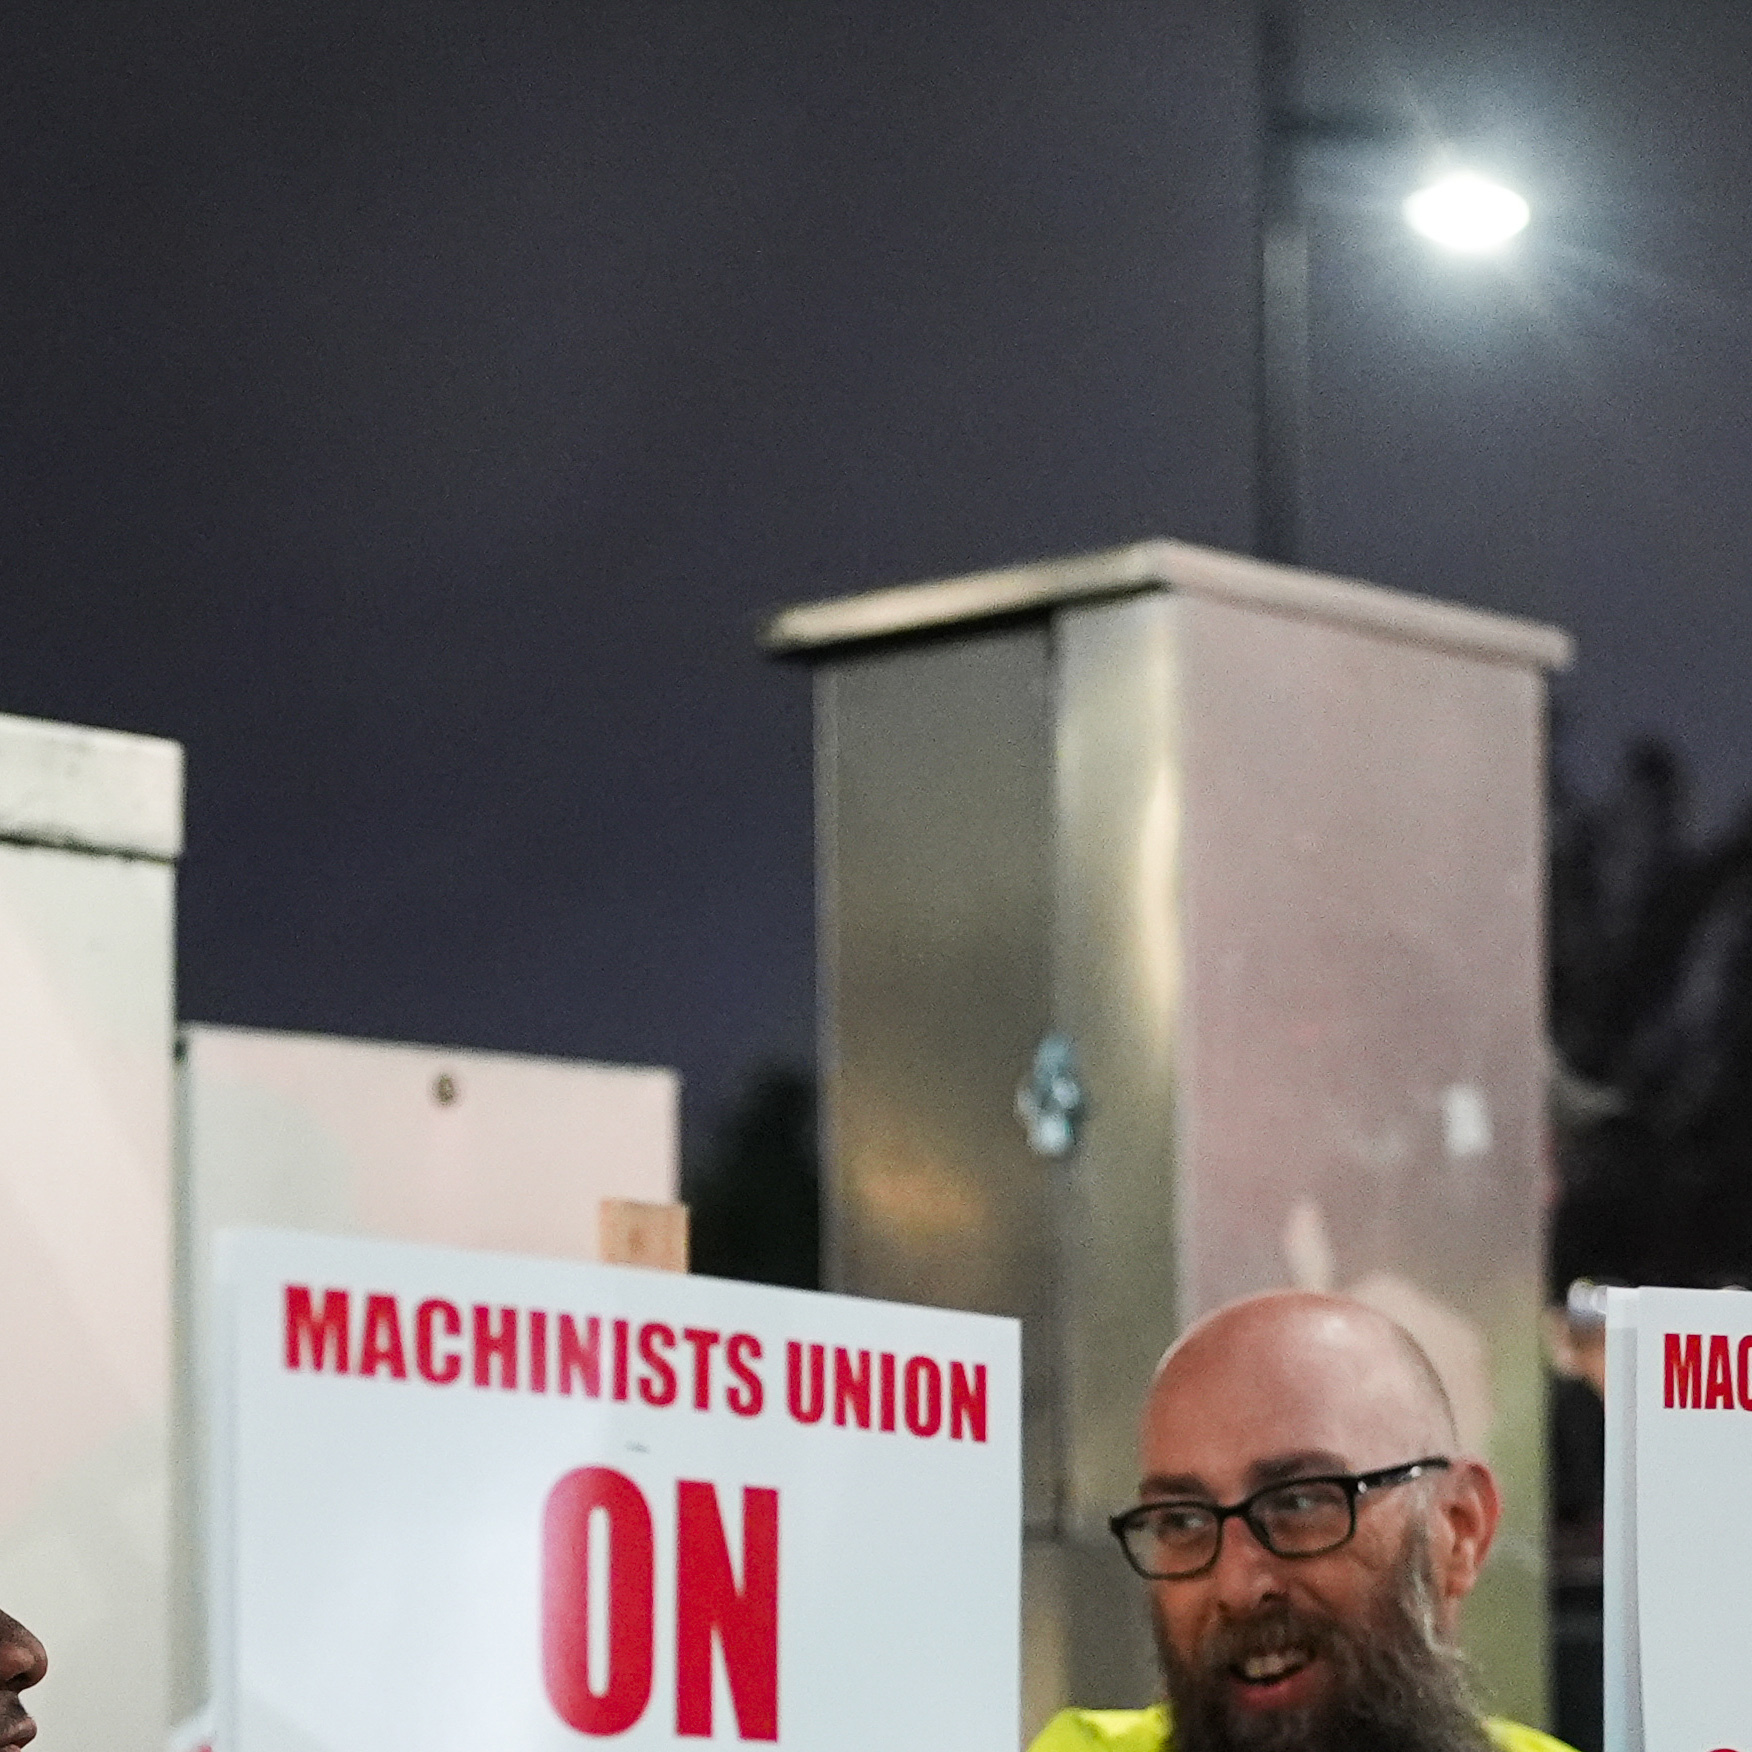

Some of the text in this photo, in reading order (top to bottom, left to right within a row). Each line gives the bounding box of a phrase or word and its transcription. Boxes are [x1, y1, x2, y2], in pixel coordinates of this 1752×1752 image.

[282, 1283, 990, 1444] MACHINISTS UNION
[539, 1464, 782, 1743] ON
